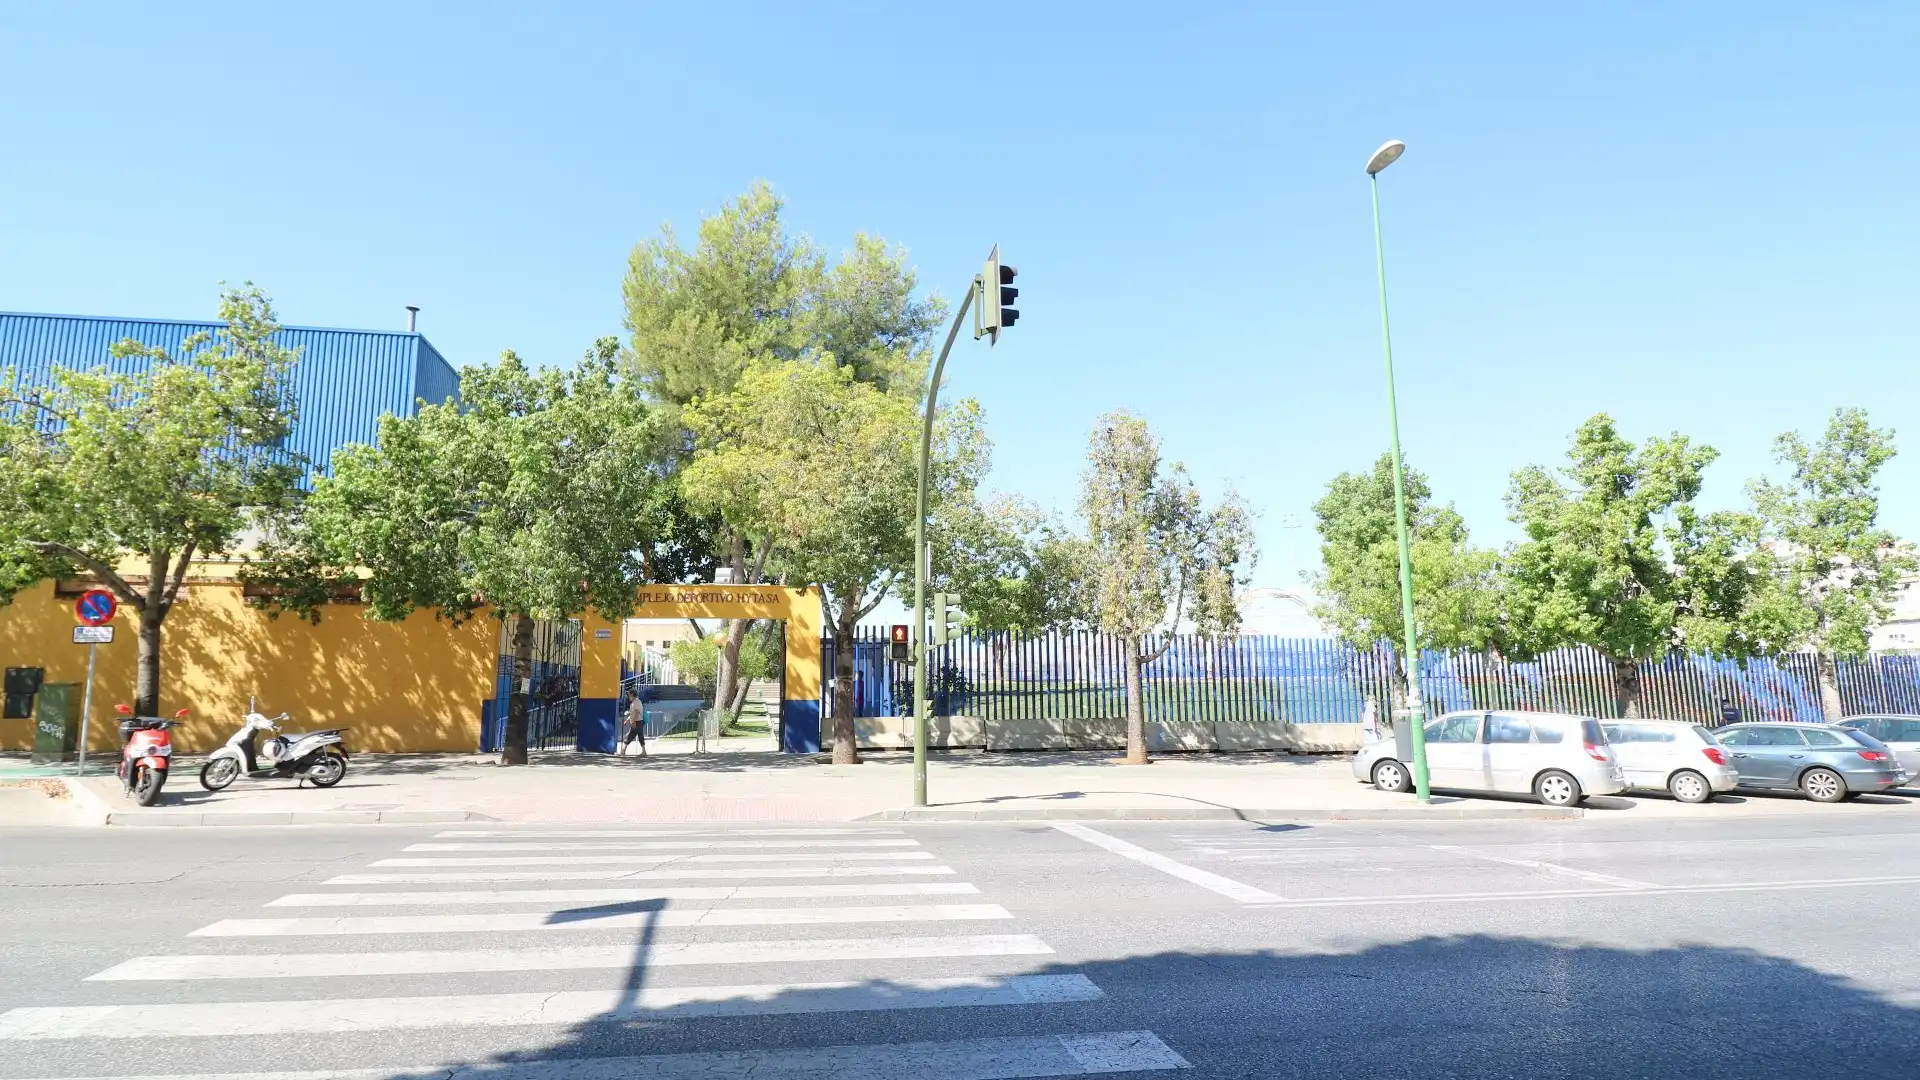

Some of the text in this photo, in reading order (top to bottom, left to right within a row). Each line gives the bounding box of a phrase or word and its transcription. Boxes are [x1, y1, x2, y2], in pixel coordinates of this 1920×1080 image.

[636, 592, 780, 604] MPLEJO DEPORTIVO HYTASA
